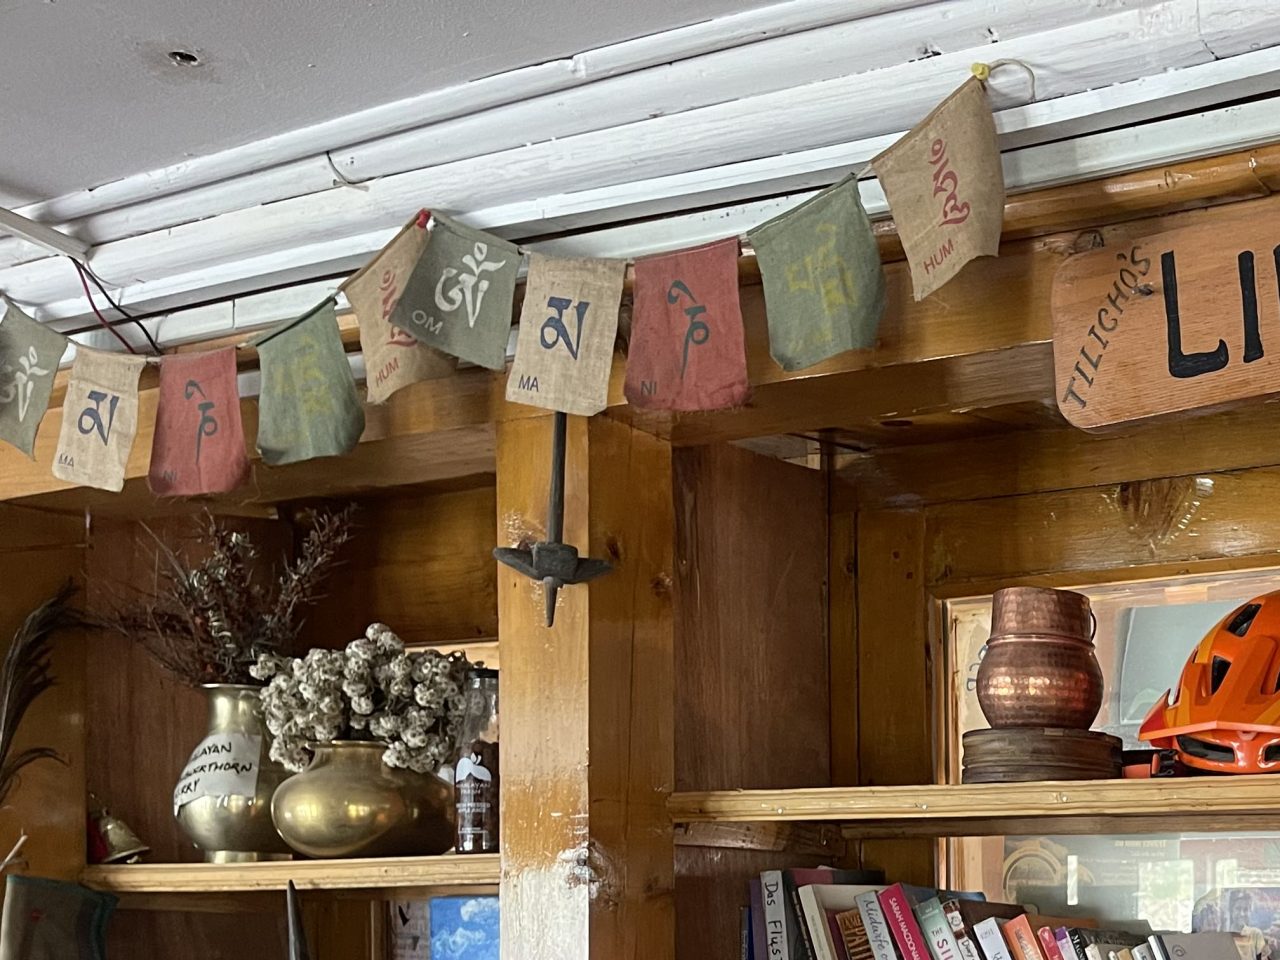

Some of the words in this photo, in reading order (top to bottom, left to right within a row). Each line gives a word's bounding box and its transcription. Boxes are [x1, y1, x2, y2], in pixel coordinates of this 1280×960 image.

[924, 242, 954, 274] HUM
[412, 310, 444, 335] OM
[1062, 245, 1150, 409] TILICHO'S
[375, 358, 399, 386] HUM
[518, 375, 539, 393] MA
[640, 381, 657, 395] NI
[58, 454, 75, 468] MA
